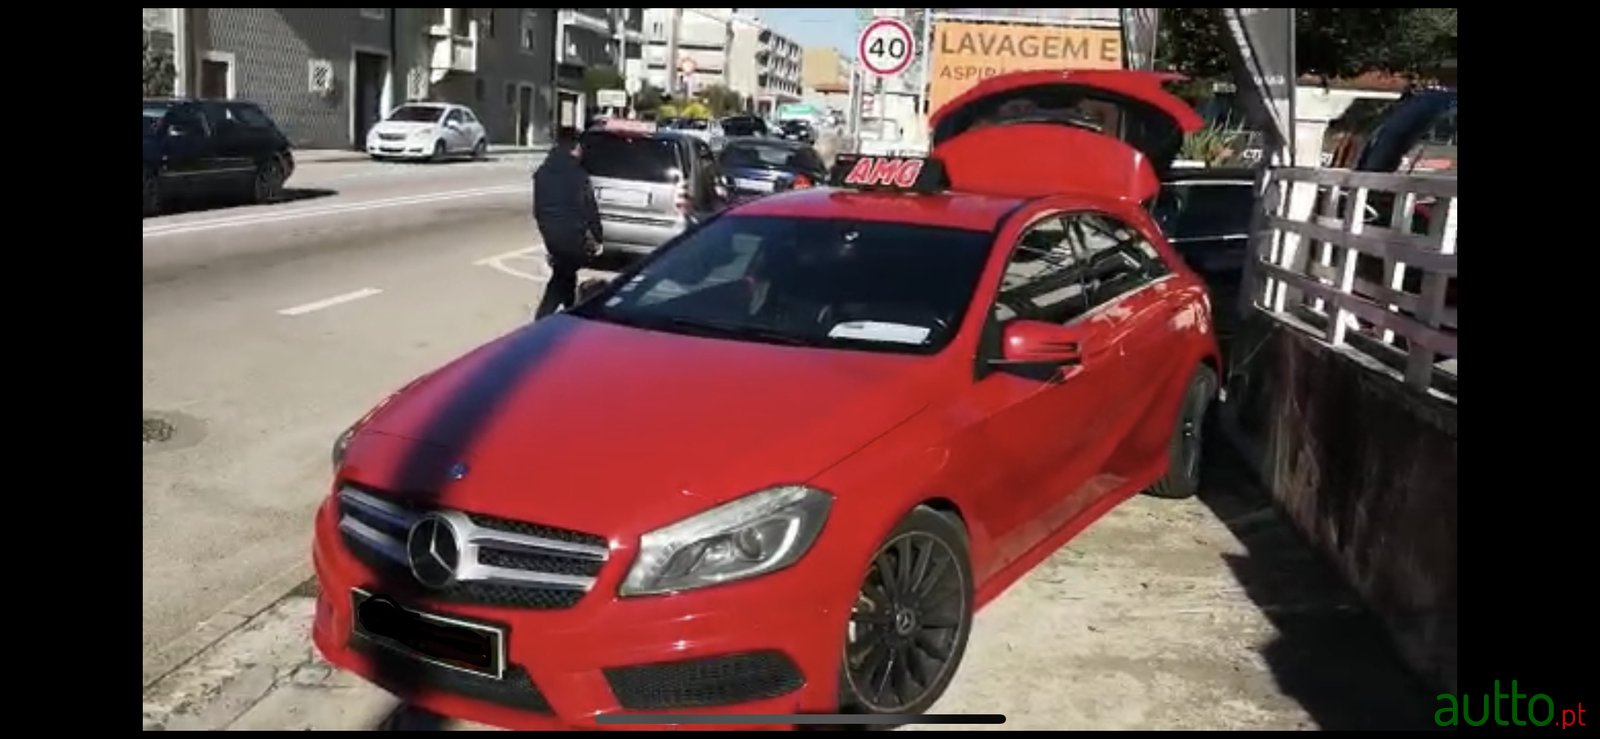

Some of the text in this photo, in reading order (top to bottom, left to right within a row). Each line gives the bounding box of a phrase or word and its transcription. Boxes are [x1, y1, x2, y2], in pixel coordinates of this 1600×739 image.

[869, 38, 905, 58] 40
[941, 30, 1118, 62] LAVAGEM E
[939, 64, 1007, 81] ASPIR
[845, 157, 924, 187] AMG
